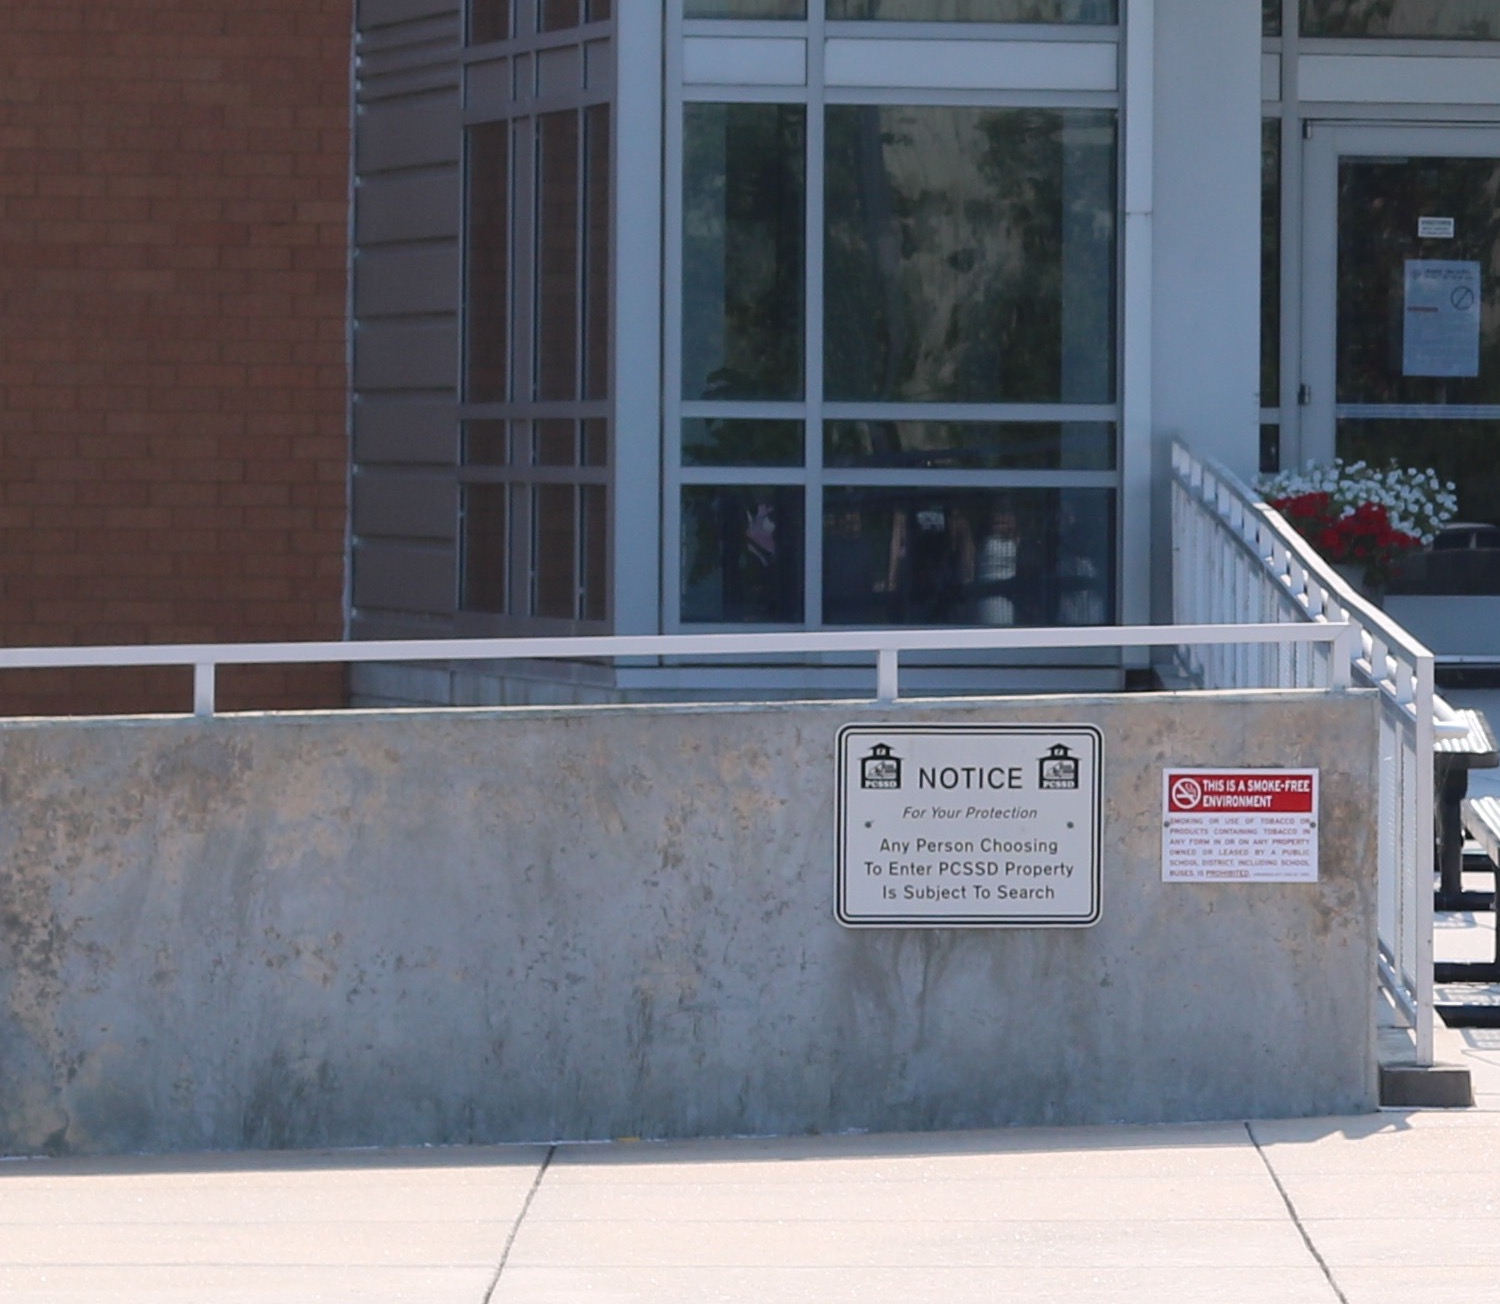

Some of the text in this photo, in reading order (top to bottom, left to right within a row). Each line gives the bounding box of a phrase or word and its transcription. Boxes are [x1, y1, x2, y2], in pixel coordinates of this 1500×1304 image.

[865, 780, 897, 788] PCSSD
[919, 767, 1023, 789] NOTICE
[1043, 780, 1075, 788] PCSSD
[1202, 780, 1310, 792] THIS IS A SMOKE-FREE
[1202, 795, 1273, 808] ENVIRONMENT
[902, 806, 1038, 819] For Your Protection
[880, 837, 1058, 854] Any Person Choosing
[864, 861, 1074, 878] To Enter PCSSD Property
[883, 885, 1055, 901] Is Subject To Search
